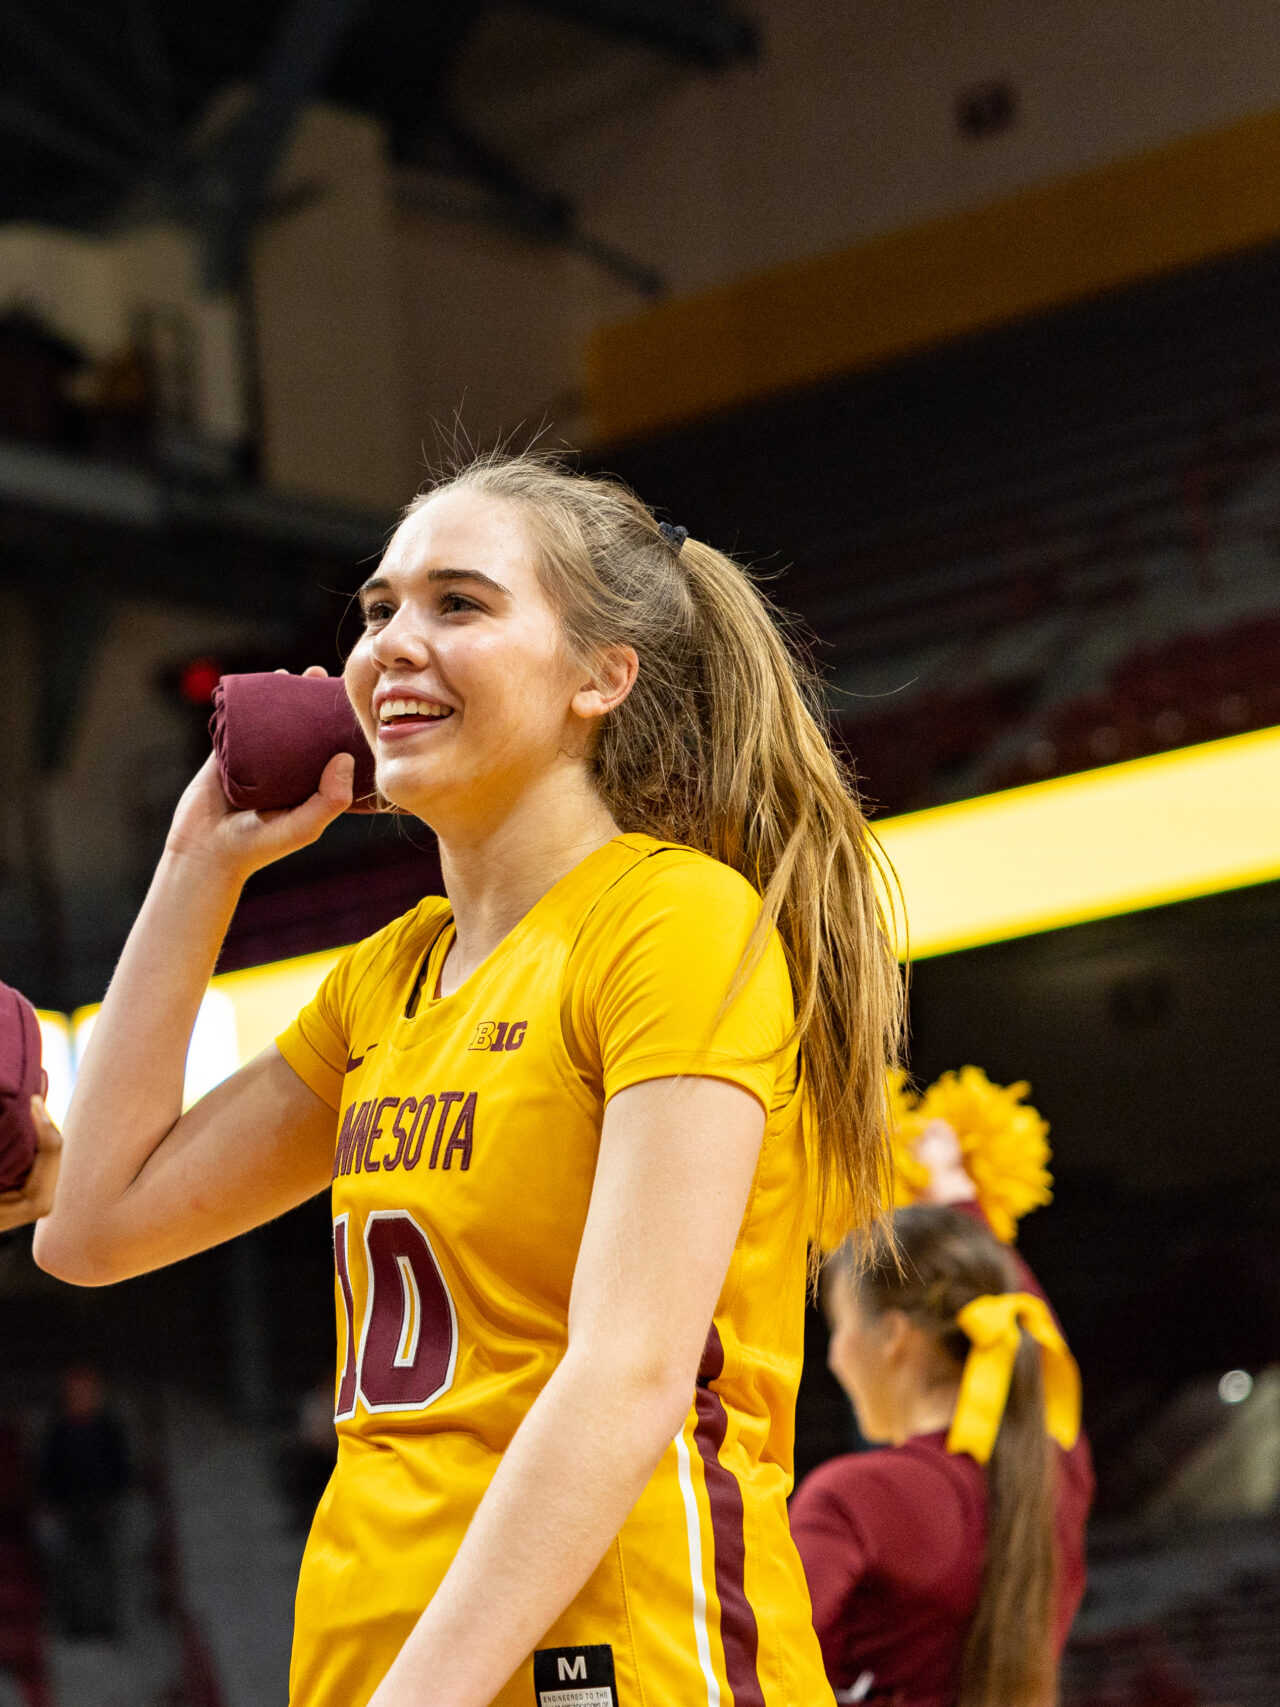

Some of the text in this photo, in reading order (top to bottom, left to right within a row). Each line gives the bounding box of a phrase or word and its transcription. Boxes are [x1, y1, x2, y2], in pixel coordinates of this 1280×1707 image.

[332, 1090, 478, 1179] NNESOTA
[333, 1210, 459, 1424] 10
[557, 1655, 588, 1681] M
[543, 1691, 609, 1703] ENGINEERED TO THE
